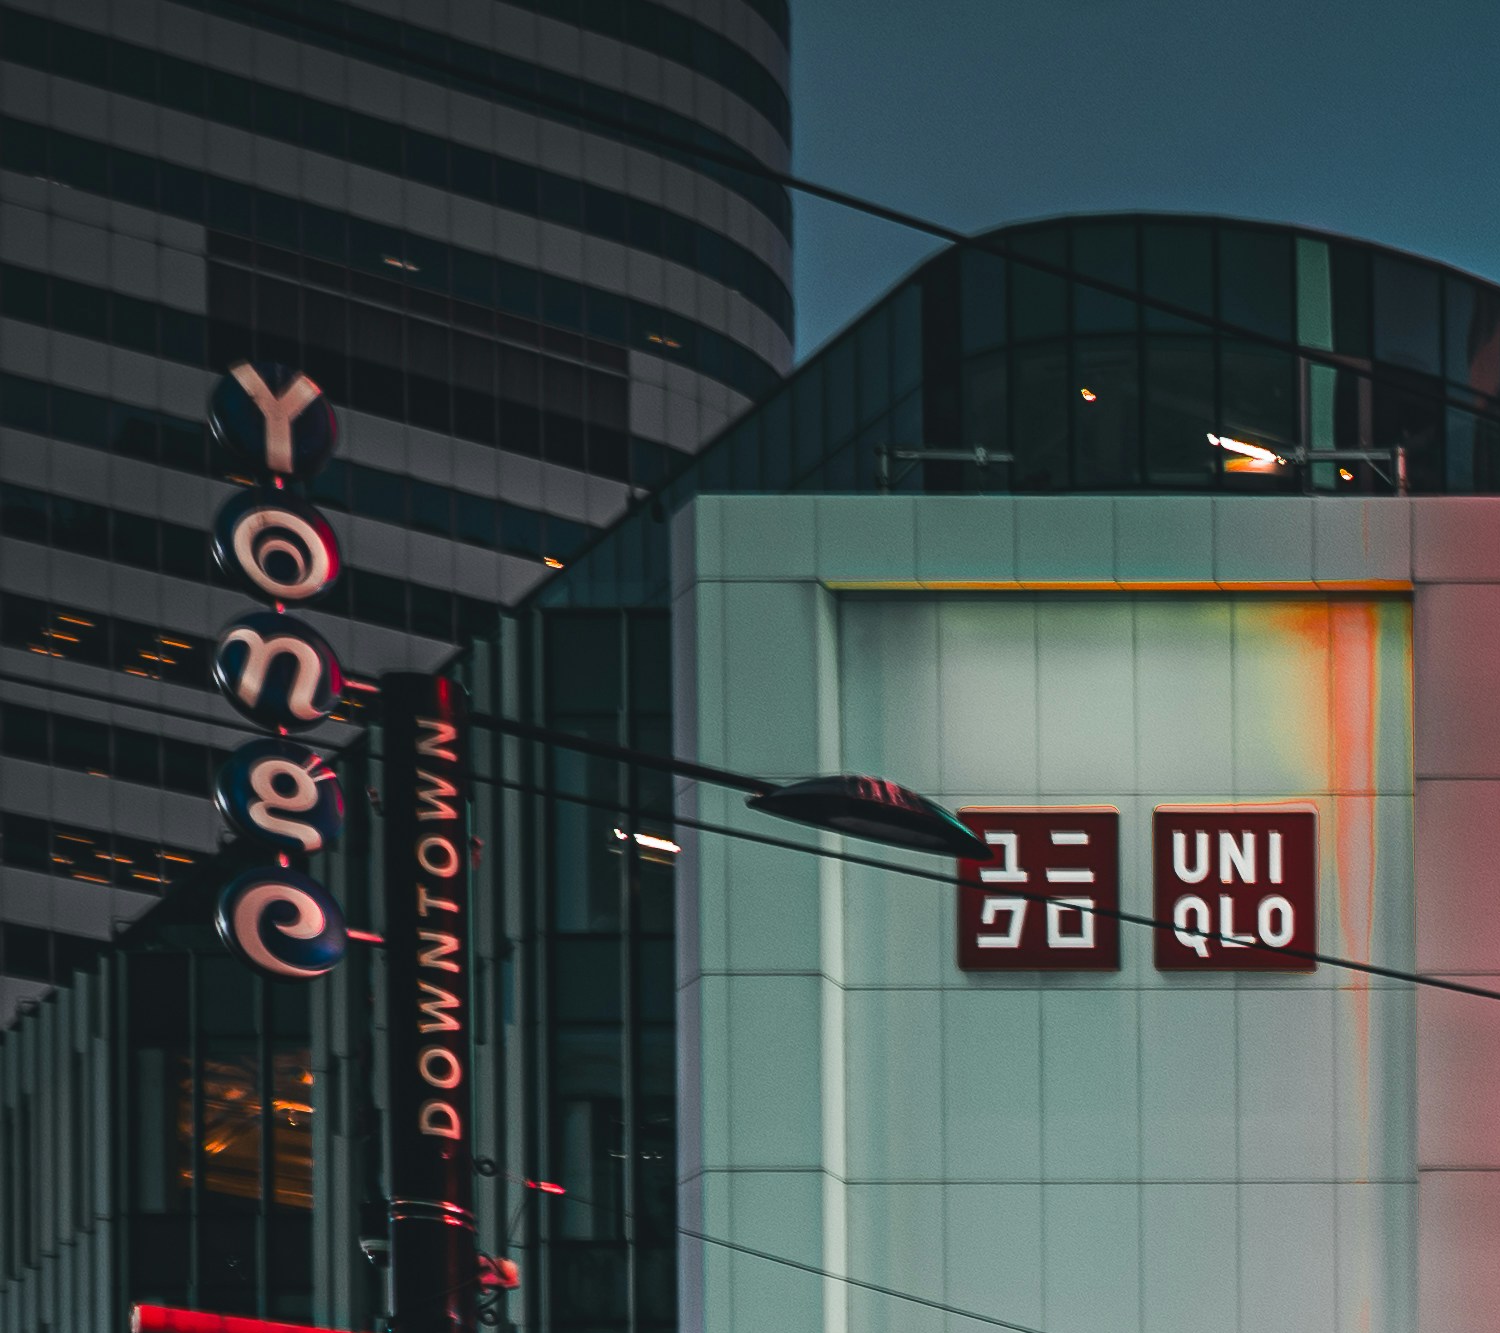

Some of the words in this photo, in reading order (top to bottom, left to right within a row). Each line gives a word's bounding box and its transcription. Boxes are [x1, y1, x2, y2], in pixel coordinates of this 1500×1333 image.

[221, 361, 339, 977] Yonge
[979, 830, 1095, 883] ユニ
[1173, 830, 1282, 884] UNI
[416, 718, 462, 1141] DOWNTOWN
[977, 895, 1096, 948] クロ
[1173, 894, 1295, 958] QLO
